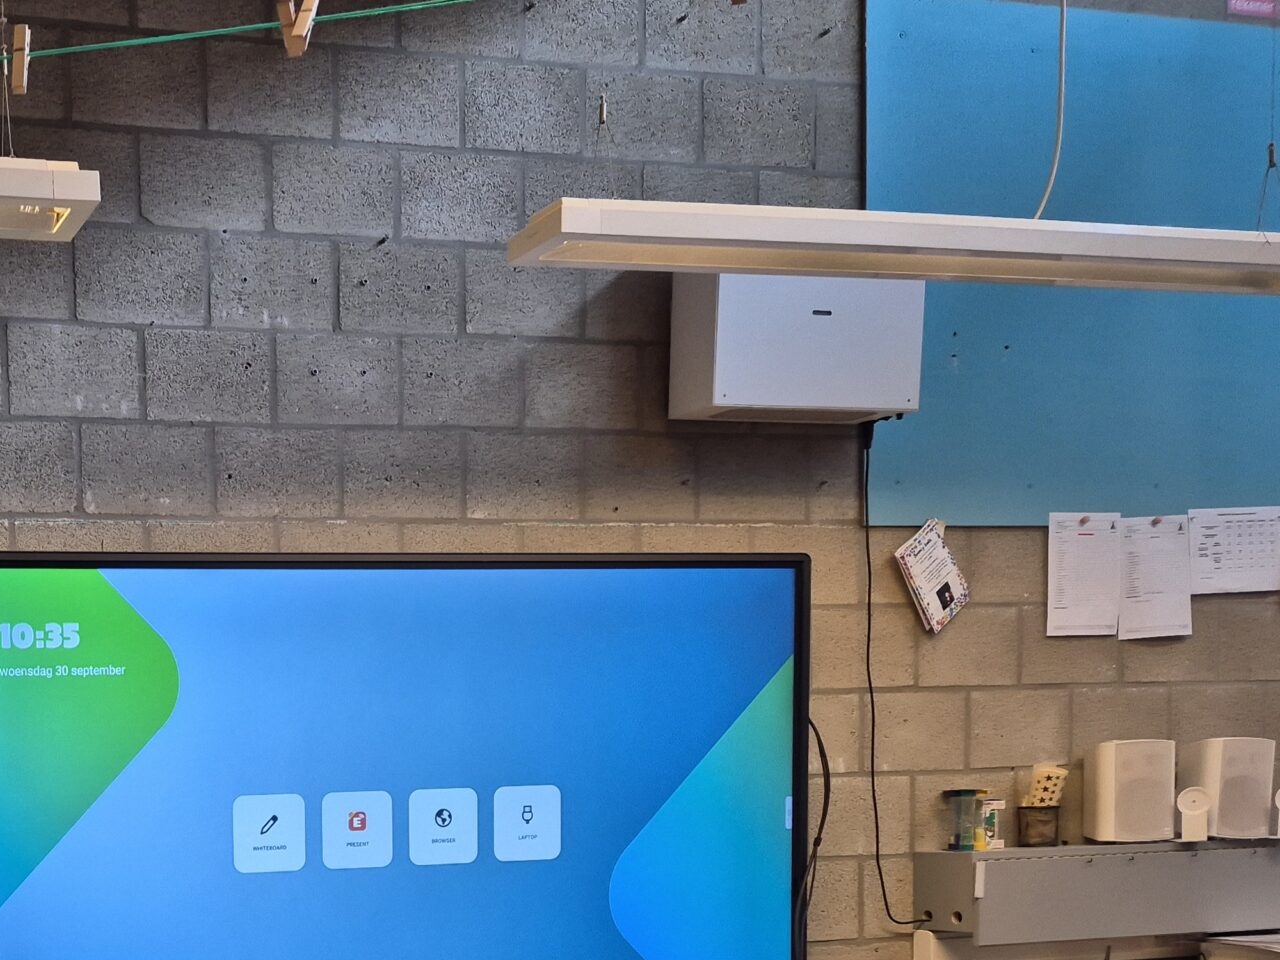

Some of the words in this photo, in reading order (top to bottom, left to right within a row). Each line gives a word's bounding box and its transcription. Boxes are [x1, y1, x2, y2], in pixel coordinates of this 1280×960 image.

[0, 666, 52, 678] woensdag
[55, 665, 68, 676] 30
[71, 665, 125, 677] september
